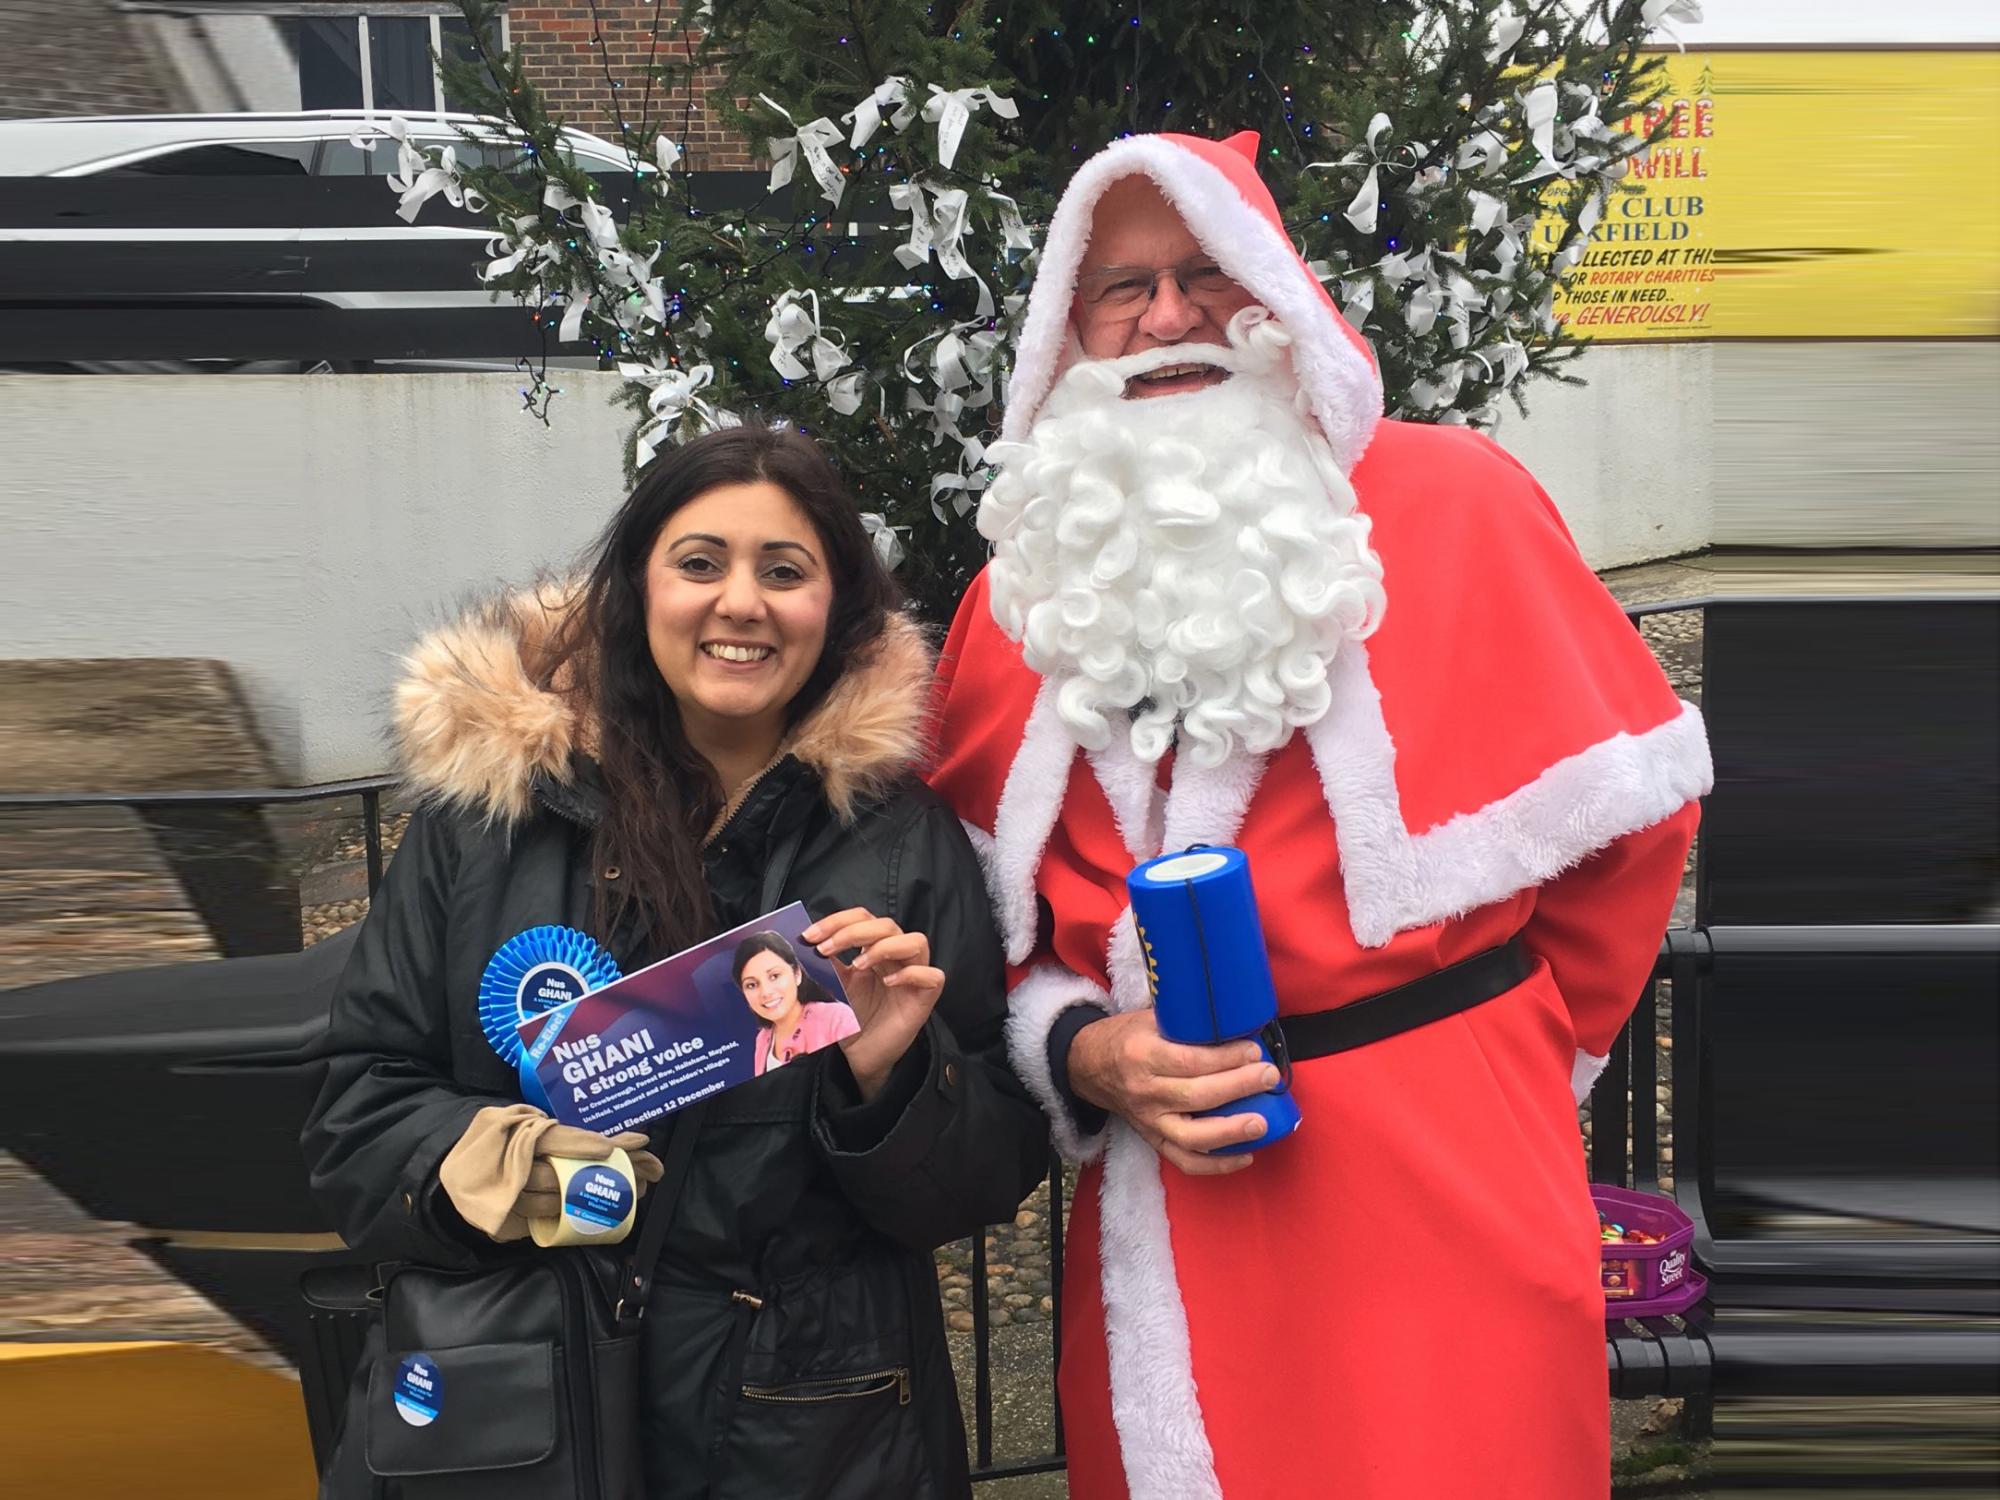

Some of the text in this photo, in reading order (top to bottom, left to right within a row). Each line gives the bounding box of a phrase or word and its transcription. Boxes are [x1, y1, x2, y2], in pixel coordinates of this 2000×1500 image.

[1628, 147, 1707, 179] WILL
[1622, 196, 1704, 218] CLUB
[1544, 221, 1689, 244] UKFIELD
[1575, 249, 1653, 267] LLECTED
[1656, 249, 1679, 266] AT
[1590, 270, 1644, 286] ROTARY
[1645, 268, 1716, 284] CHARITIES
[1565, 290, 1608, 305] THOSE
[1611, 289, 1628, 303] IN
[1577, 303, 1711, 326] GENEROUSLY!
[546, 977, 566, 989] Nus
[538, 987, 572, 1001] GHANI
[530, 1012, 566, 1058] Re-Elect
[552, 1033, 602, 1064] Nus
[562, 1028, 655, 1085] GHANI
[573, 1036, 704, 1103] A strong voice
[646, 1086, 660, 1097] and
[601, 1079, 727, 1136] eral Election 12 December
[594, 1173, 616, 1188] Nus
[584, 1182, 621, 1202] GHANI
[1660, 1252, 1686, 1275] Quality
[1661, 1267, 1683, 1287] Street
[413, 1362, 429, 1378] Nus
[406, 1372, 433, 1392] GHANI
